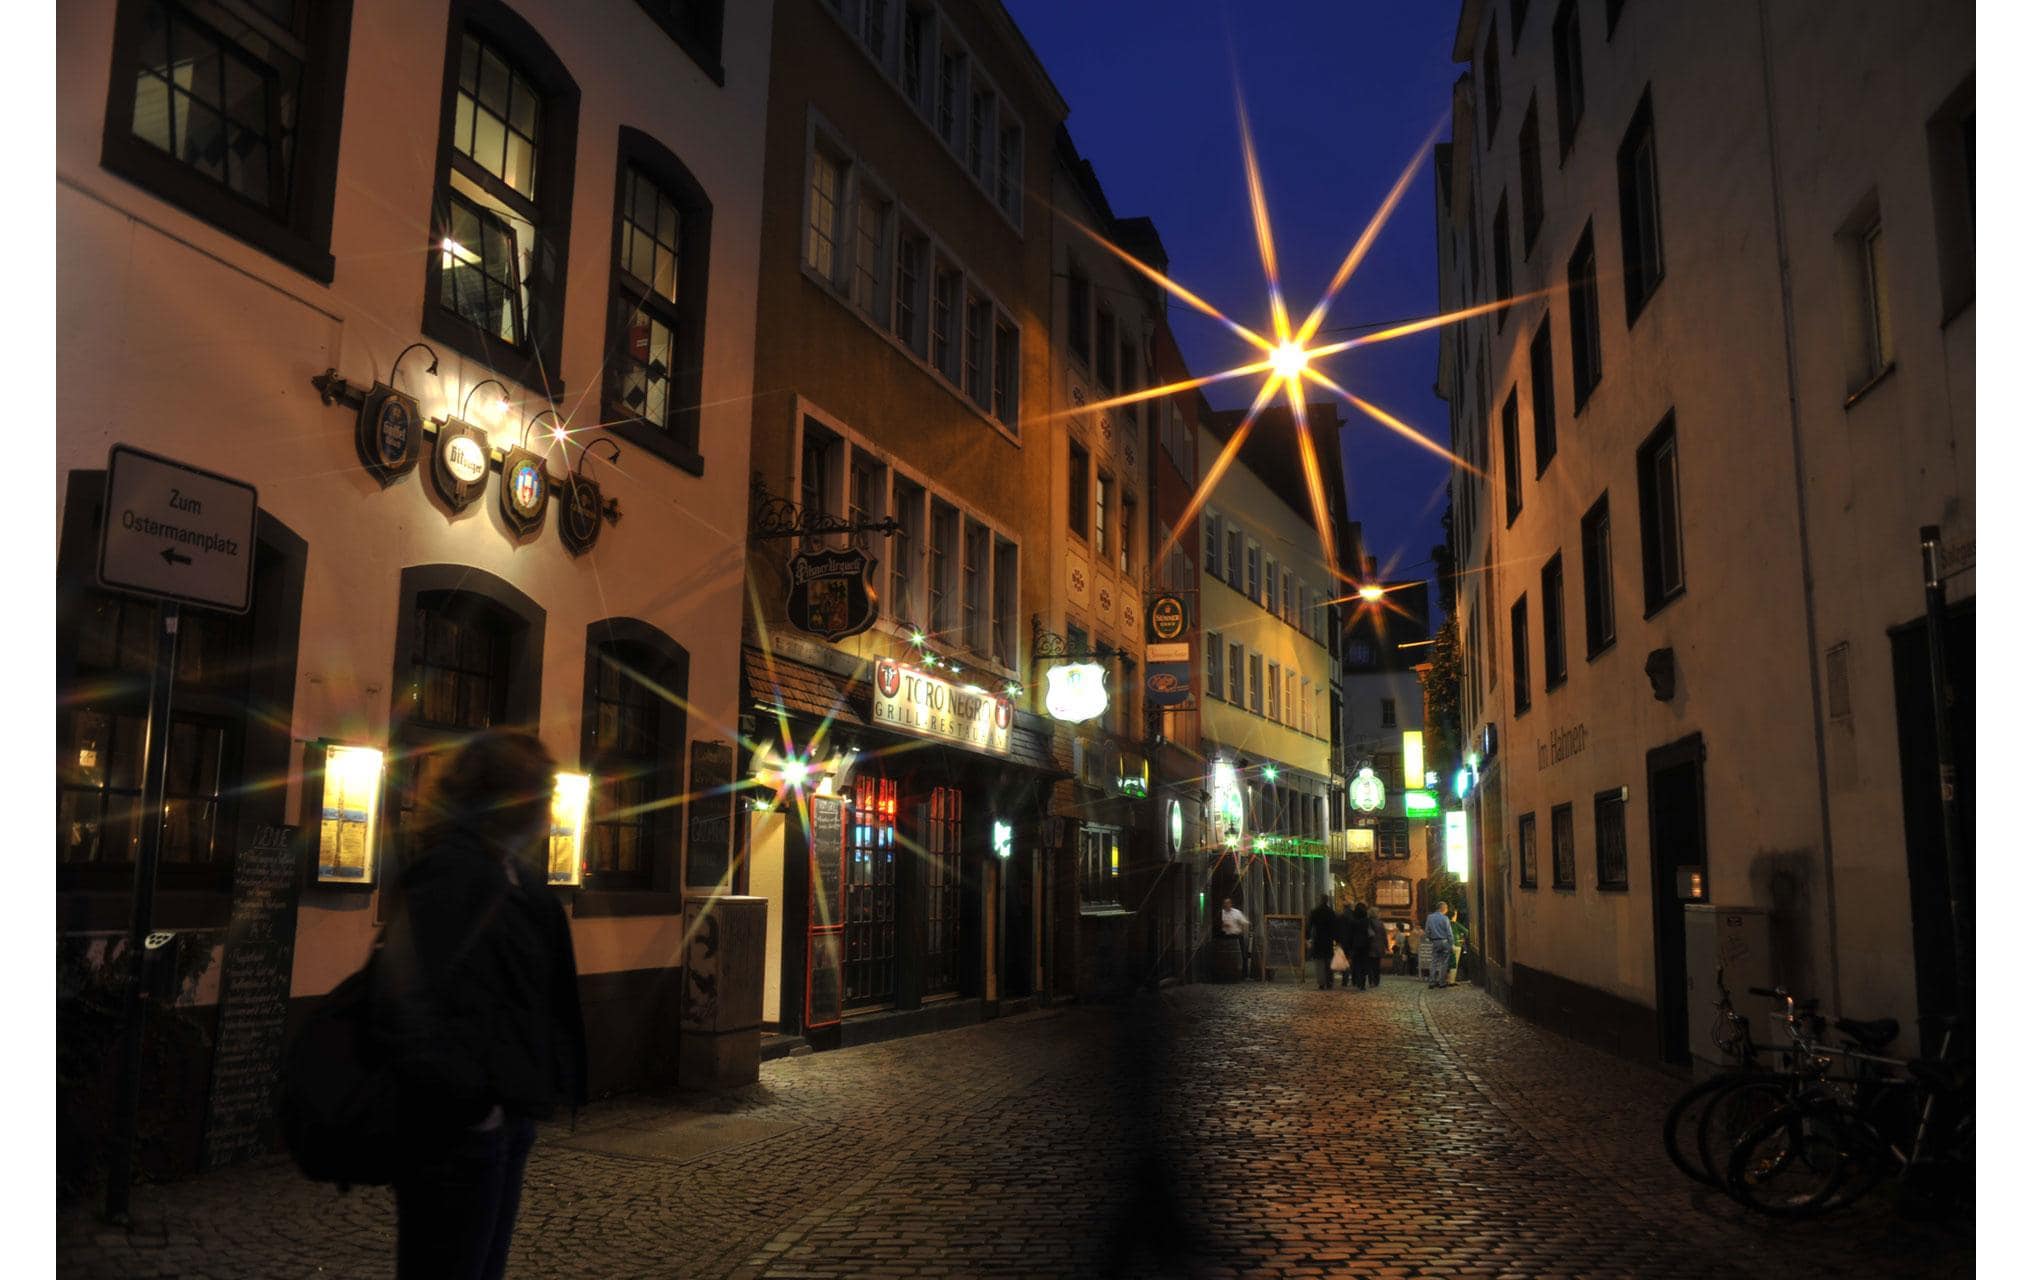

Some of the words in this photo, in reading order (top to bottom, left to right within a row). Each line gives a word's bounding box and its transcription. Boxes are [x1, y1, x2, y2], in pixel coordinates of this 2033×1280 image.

[168, 488, 202, 517] Zum
[122, 509, 239, 557] Ostermannplatz
[904, 674, 945, 711] TORO
[947, 687, 992, 722] NEGRO
[875, 701, 1008, 748] GRILL-RESTAURAN
[1537, 738, 1549, 771] Im
[1550, 723, 1586, 766] Hahnen
